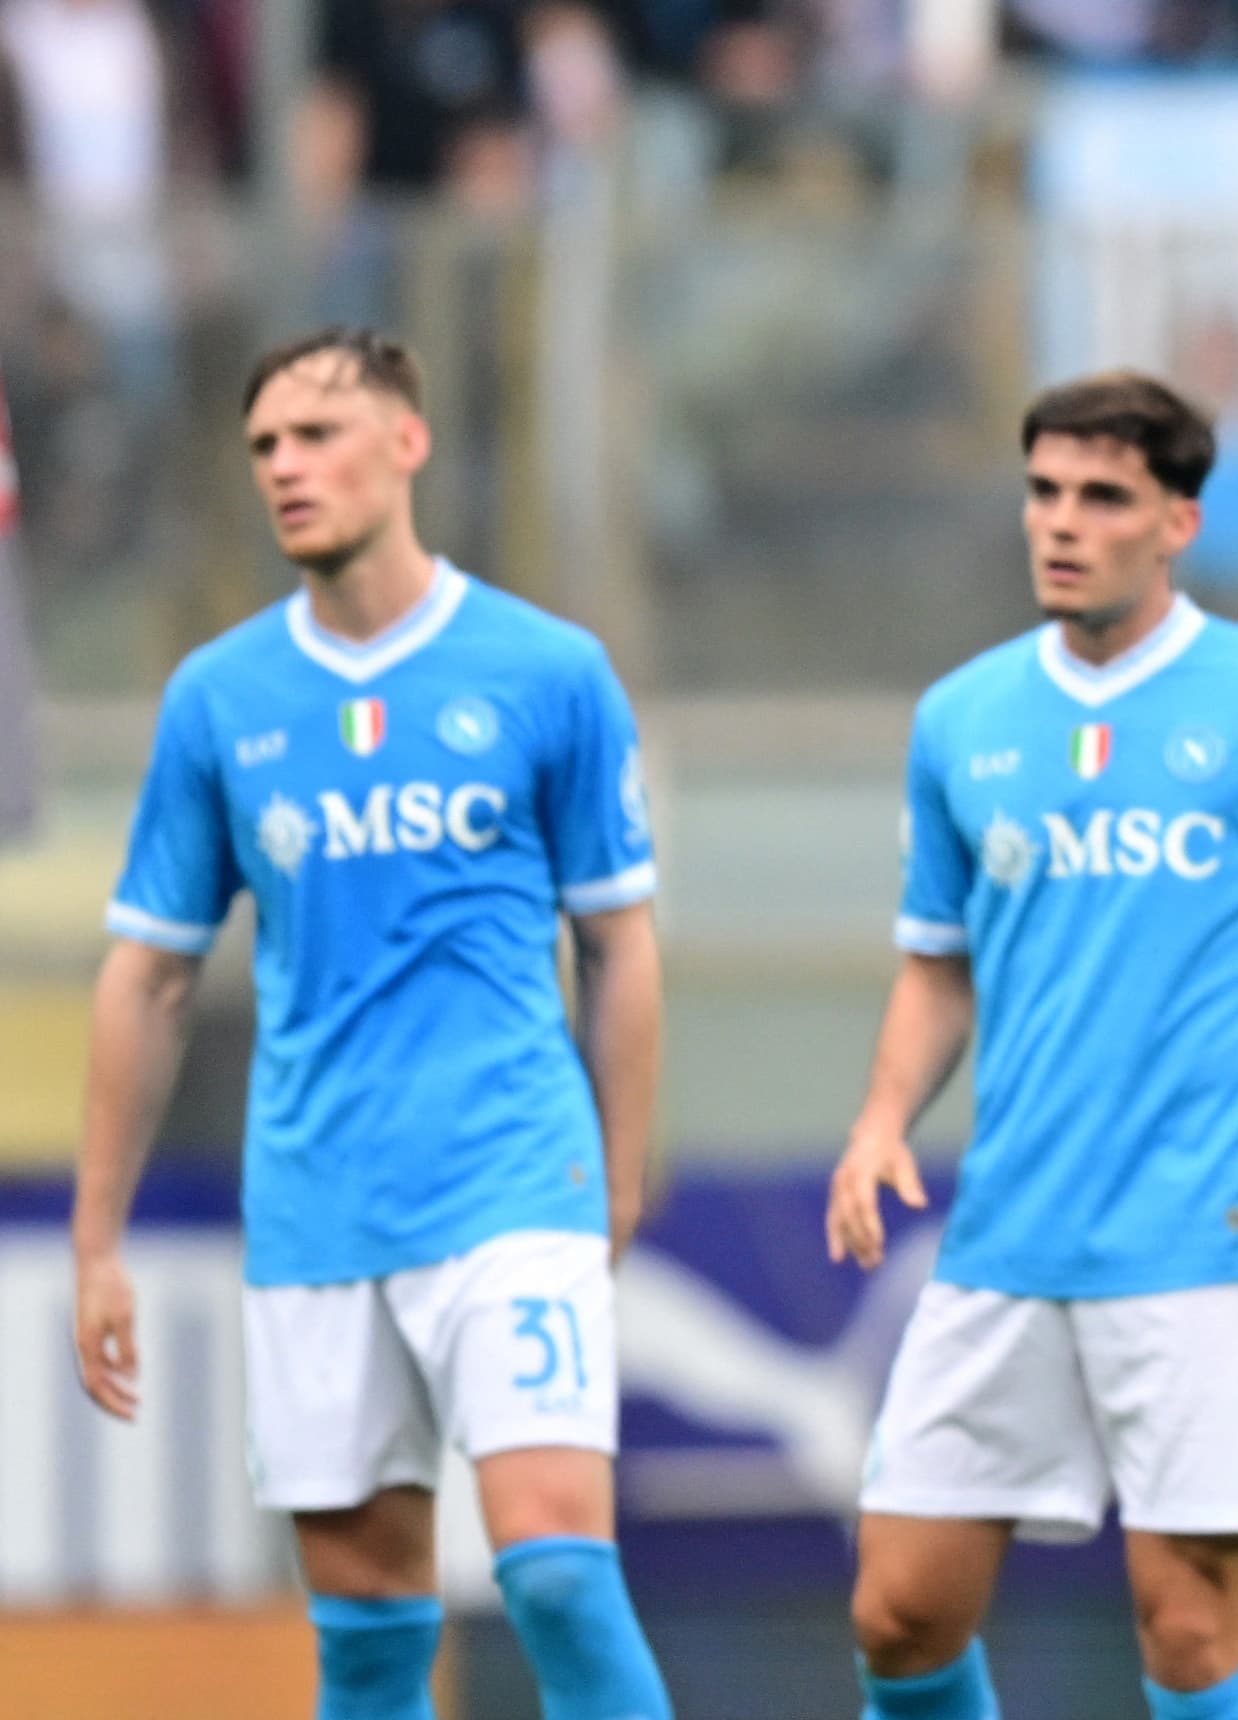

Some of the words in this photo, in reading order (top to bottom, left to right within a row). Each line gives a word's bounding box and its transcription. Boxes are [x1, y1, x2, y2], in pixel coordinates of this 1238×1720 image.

[317, 781, 506, 859] MSC
[1042, 809, 1226, 879] MSC
[510, 1296, 588, 1388] 31
